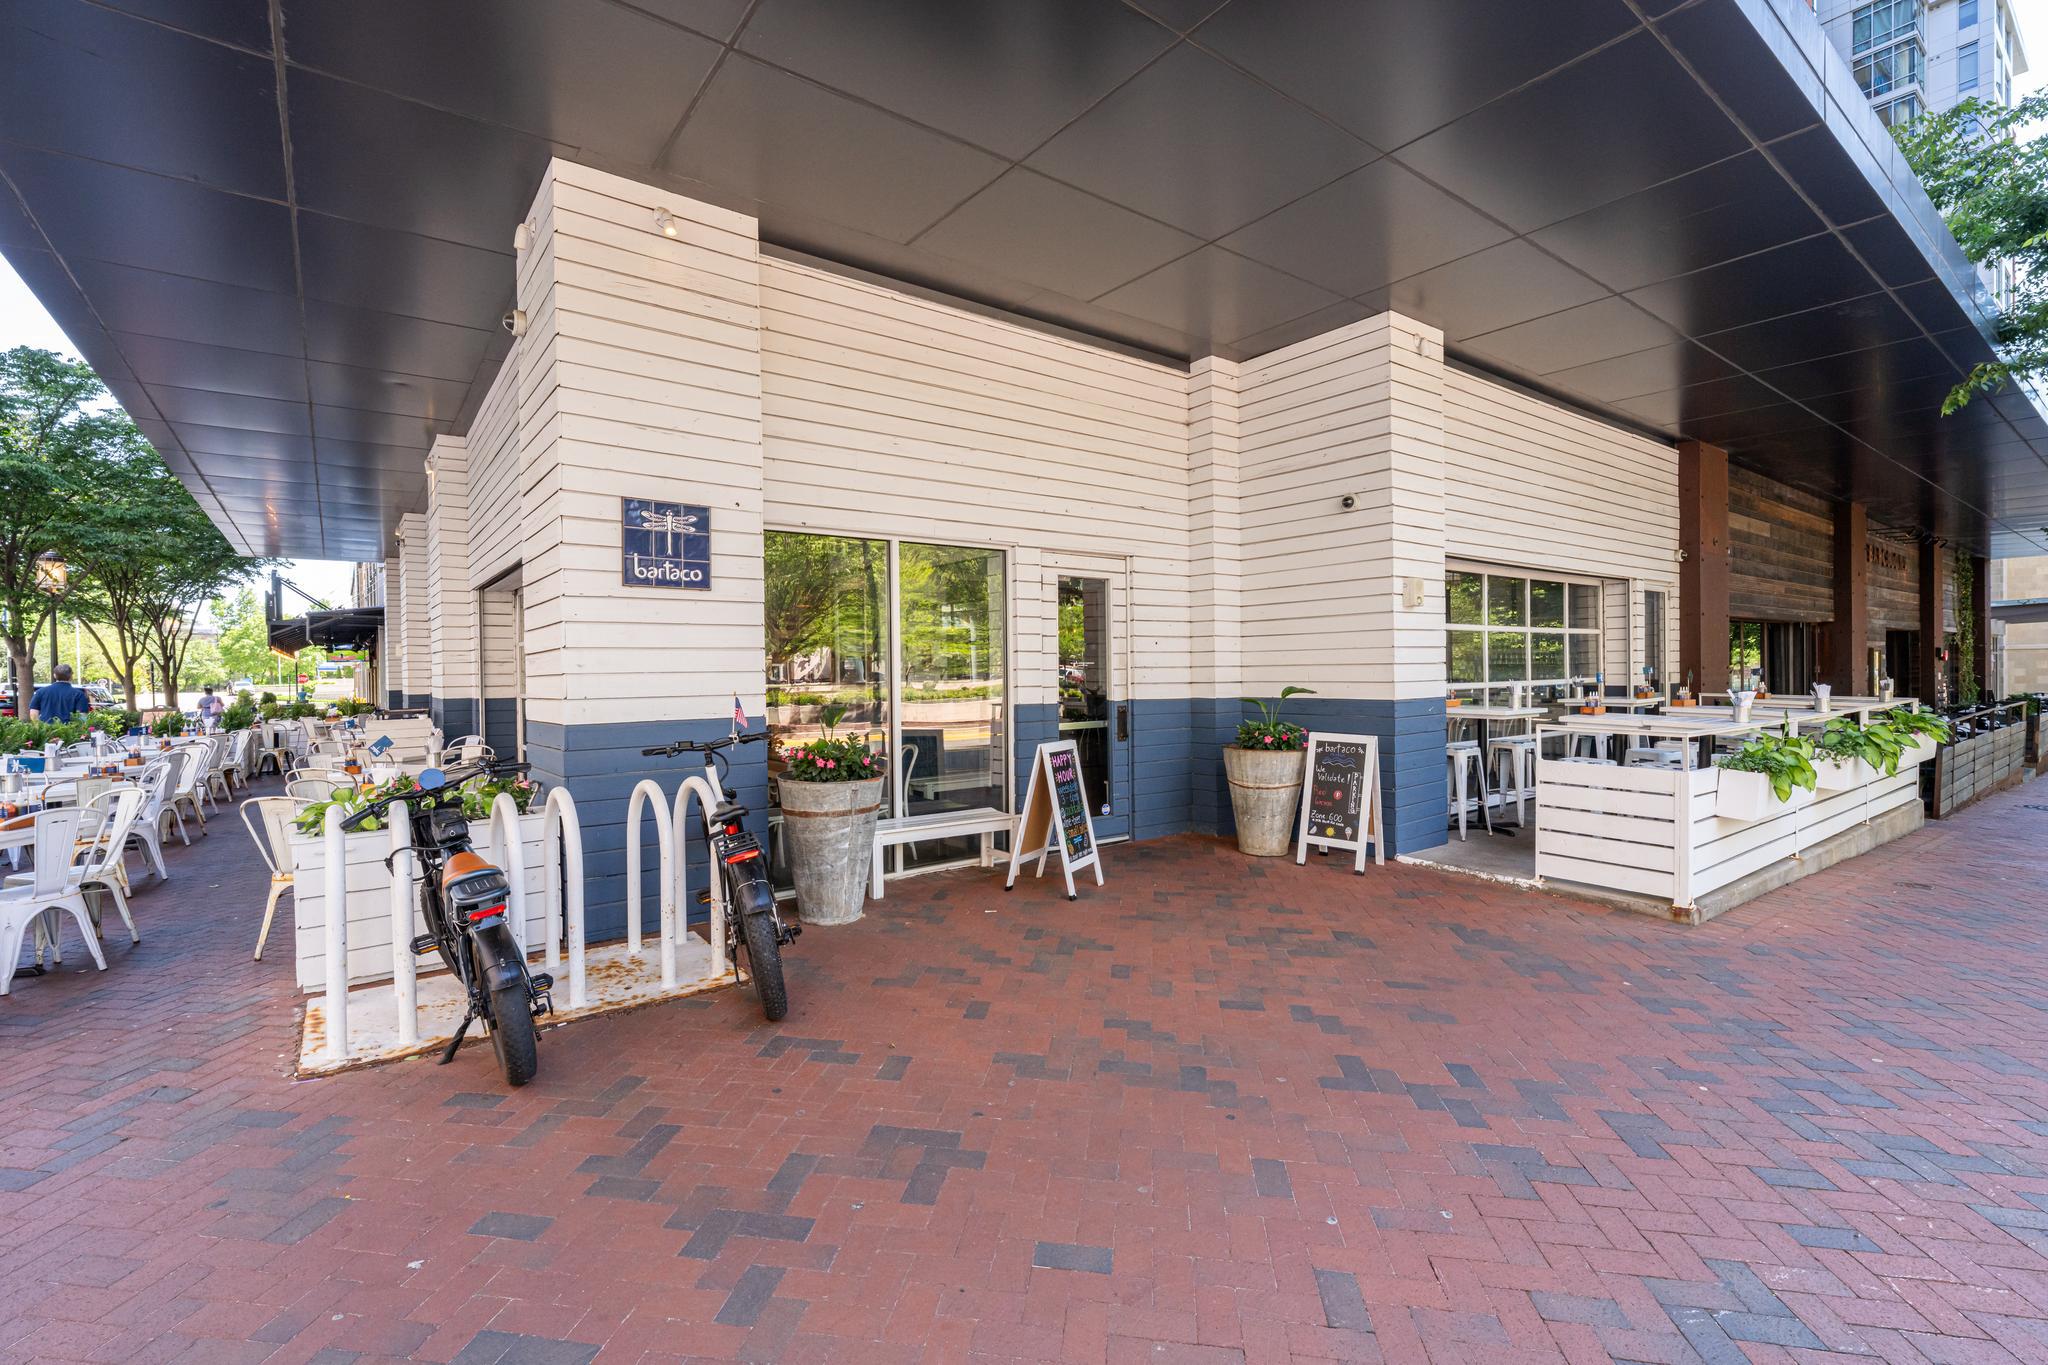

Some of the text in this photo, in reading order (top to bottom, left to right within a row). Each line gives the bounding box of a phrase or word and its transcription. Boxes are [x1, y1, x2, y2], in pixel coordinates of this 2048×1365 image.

[633, 553, 702, 581] bartaco
[1325, 742, 1356, 756] bartaco
[1051, 754, 1072, 768] HAPPY
[1315, 764, 1326, 772] We
[1057, 768, 1073, 783] HOUR
[1350, 773, 1358, 814] PARKING
[1311, 810, 1343, 822] Zone 600
